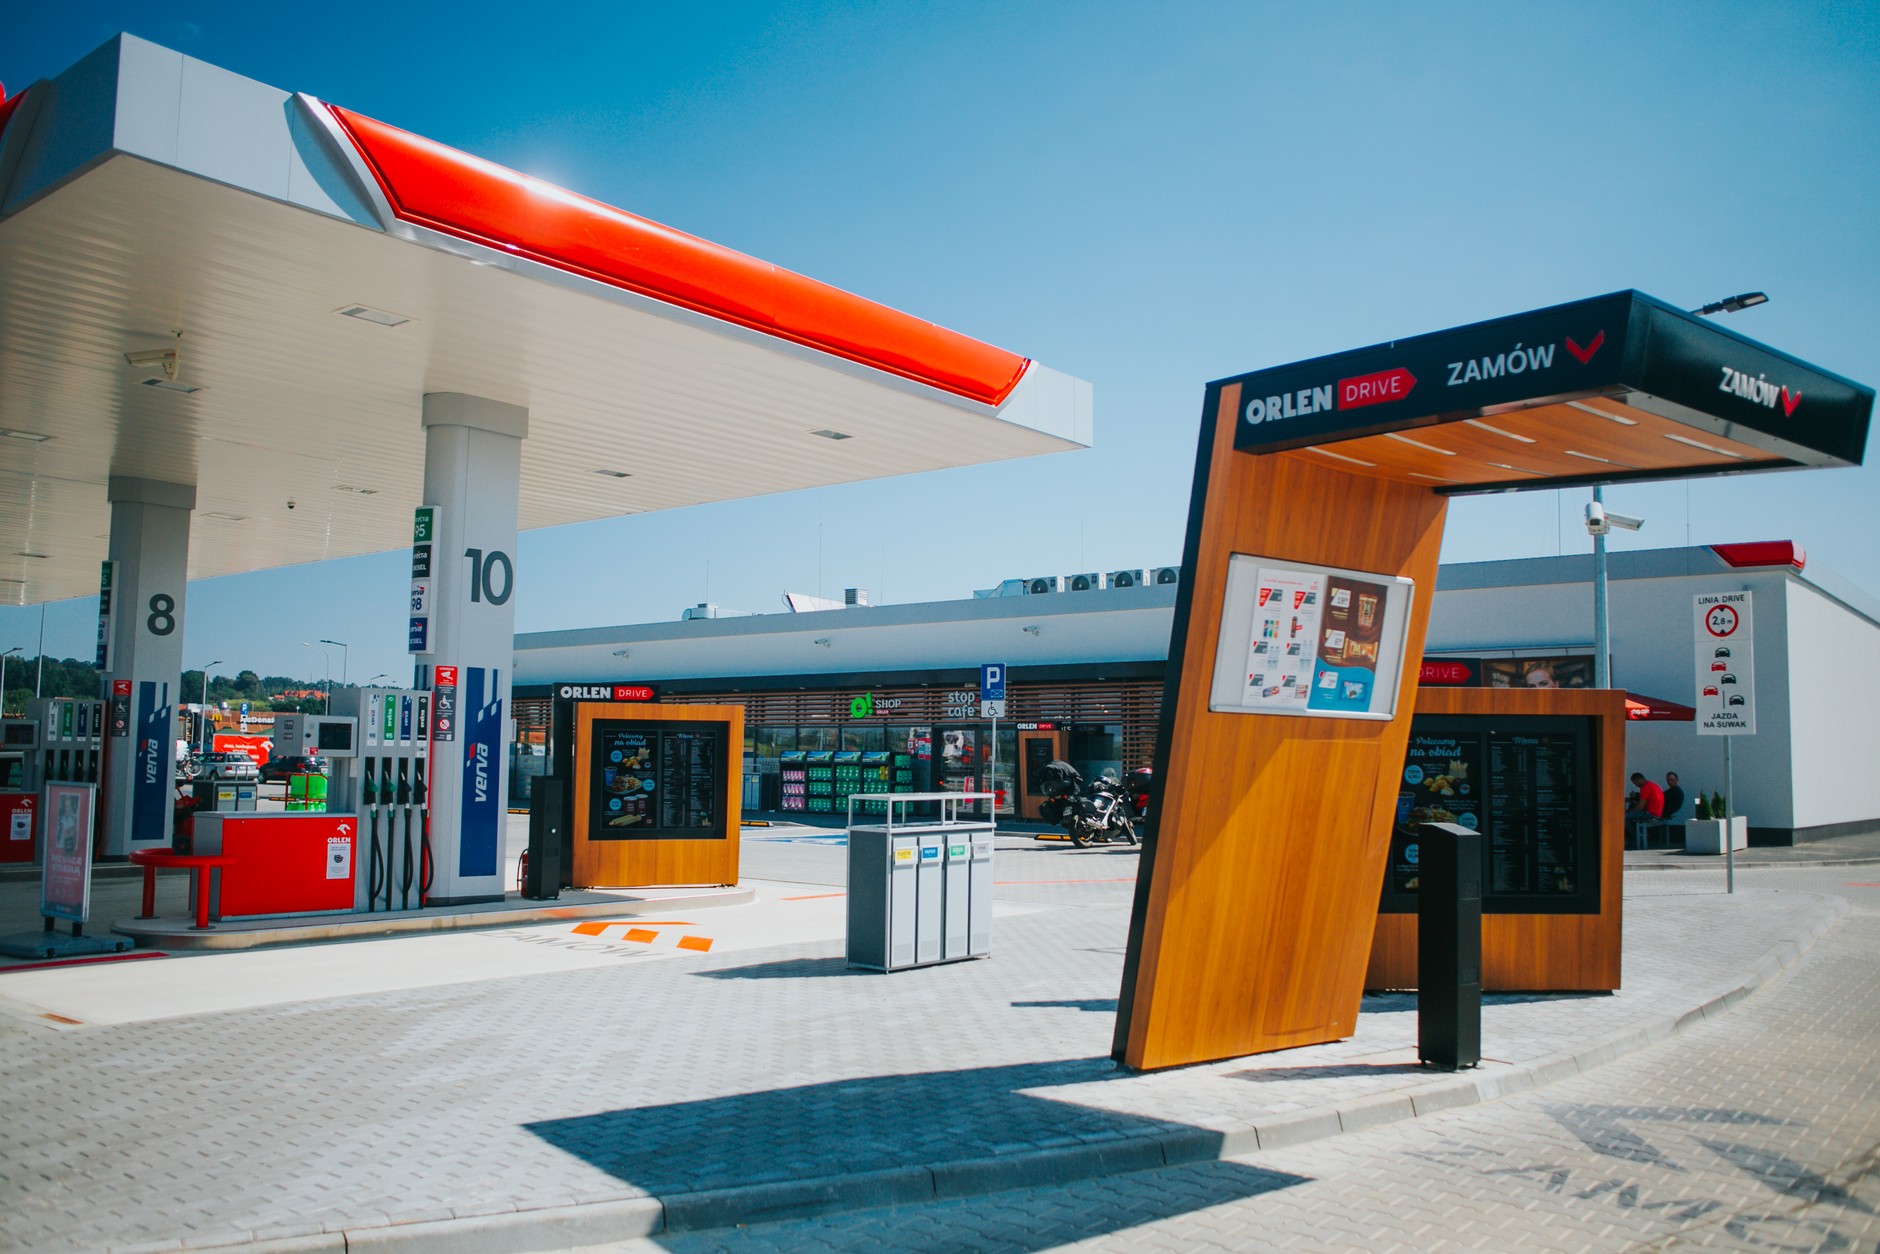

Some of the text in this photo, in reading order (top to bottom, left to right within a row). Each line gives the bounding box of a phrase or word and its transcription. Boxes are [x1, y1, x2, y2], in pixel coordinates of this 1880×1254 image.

[1447, 342, 1556, 386] ZAMÓW
[1719, 366, 1780, 408] ZAMÓW
[1245, 375, 1401, 425] ORLEN DRIVE
[464, 547, 514, 606] 10
[1698, 594, 1745, 604] LINIA DRIVE
[147, 593, 176, 637] 8
[1712, 615, 1726, 626] 2,8
[986, 666, 1001, 690] P
[560, 685, 648, 699] ORLEN DRIVE
[875, 699, 901, 709] SHOP
[948, 705, 975, 718] cafe
[1711, 712, 1738, 720] JAZDA
[1410, 746, 1463, 757] na obiad
[1415, 736, 1456, 748] Polecamy
[146, 738, 159, 784] verva
[475, 742, 489, 803] verva
